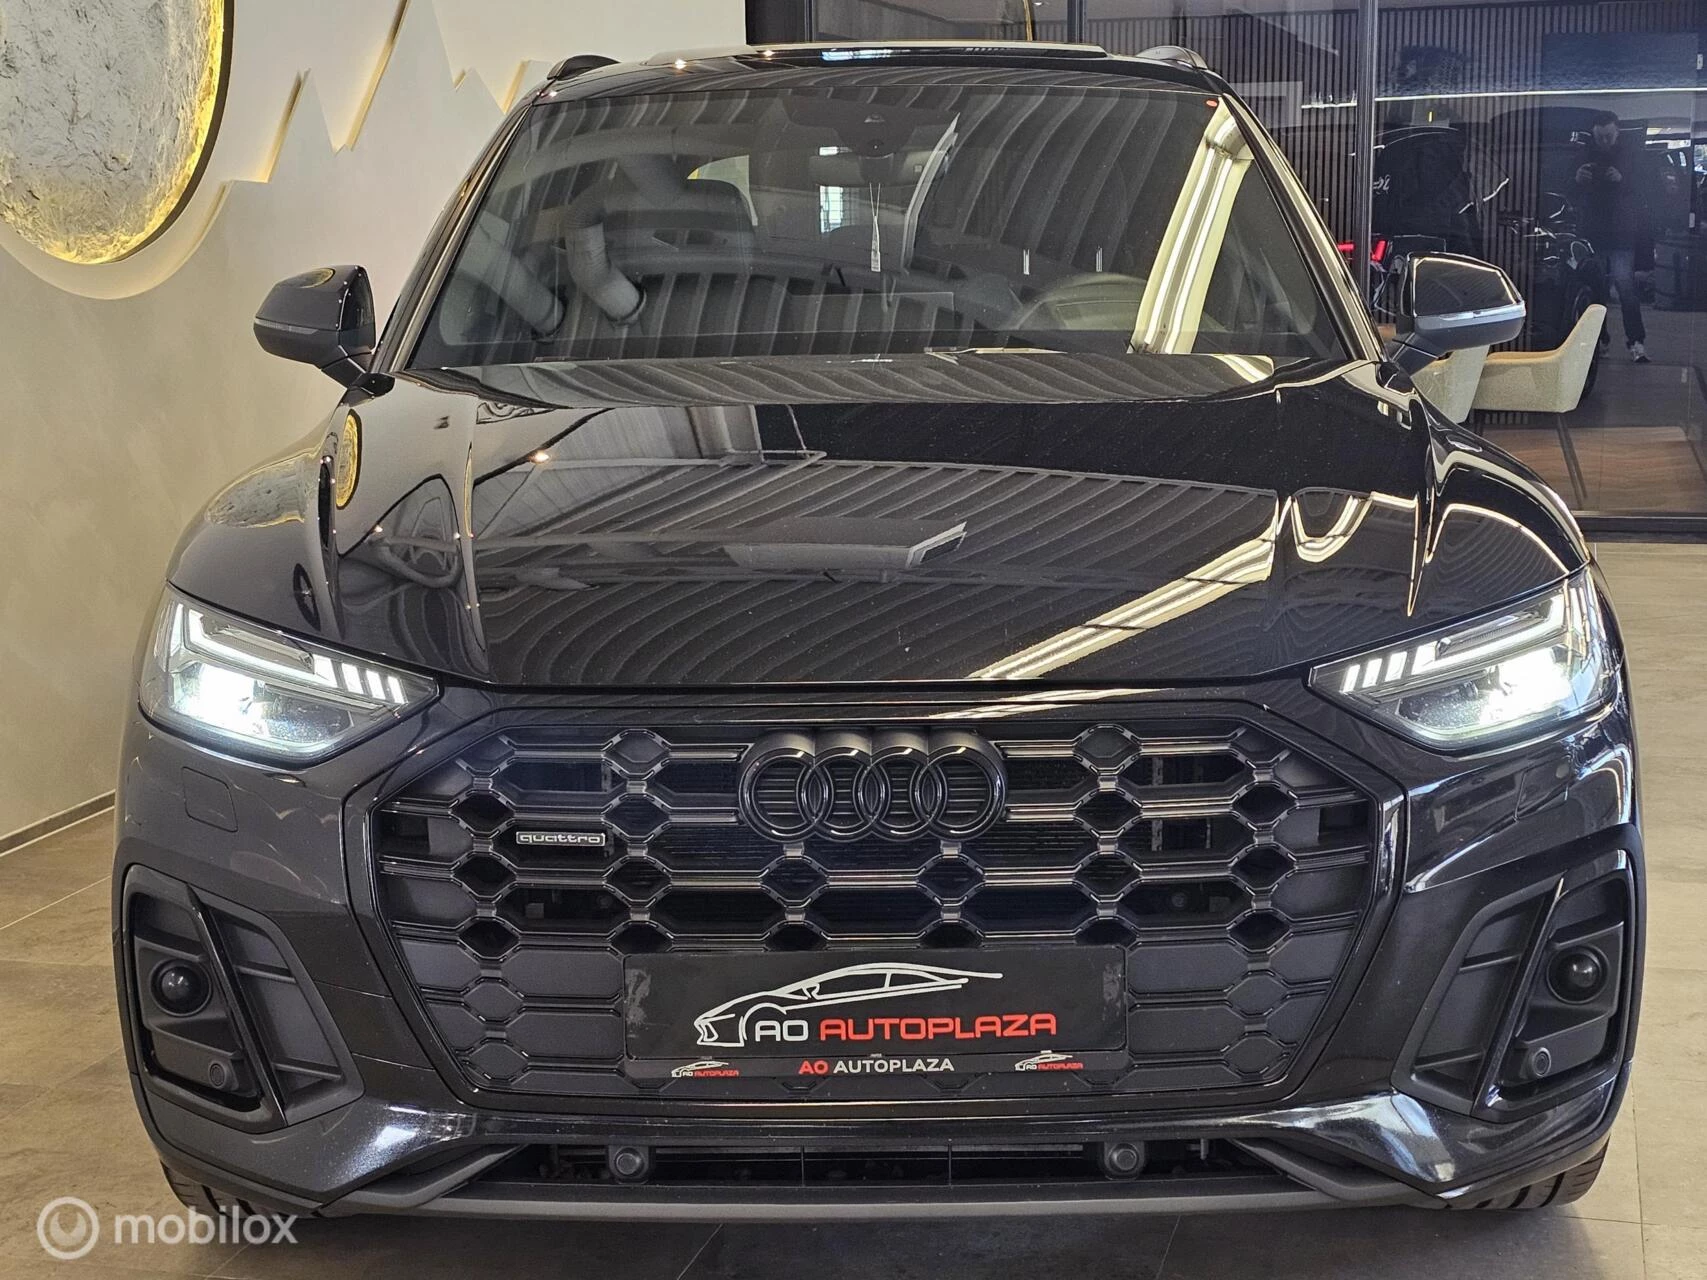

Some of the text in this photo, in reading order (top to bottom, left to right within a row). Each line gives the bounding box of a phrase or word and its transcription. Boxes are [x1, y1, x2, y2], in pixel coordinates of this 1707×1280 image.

[519, 834, 601, 844] quattro
[755, 1013, 1057, 1042] AO AUTOPLAZA
[798, 1058, 954, 1075] AO AUTOPLAZA
